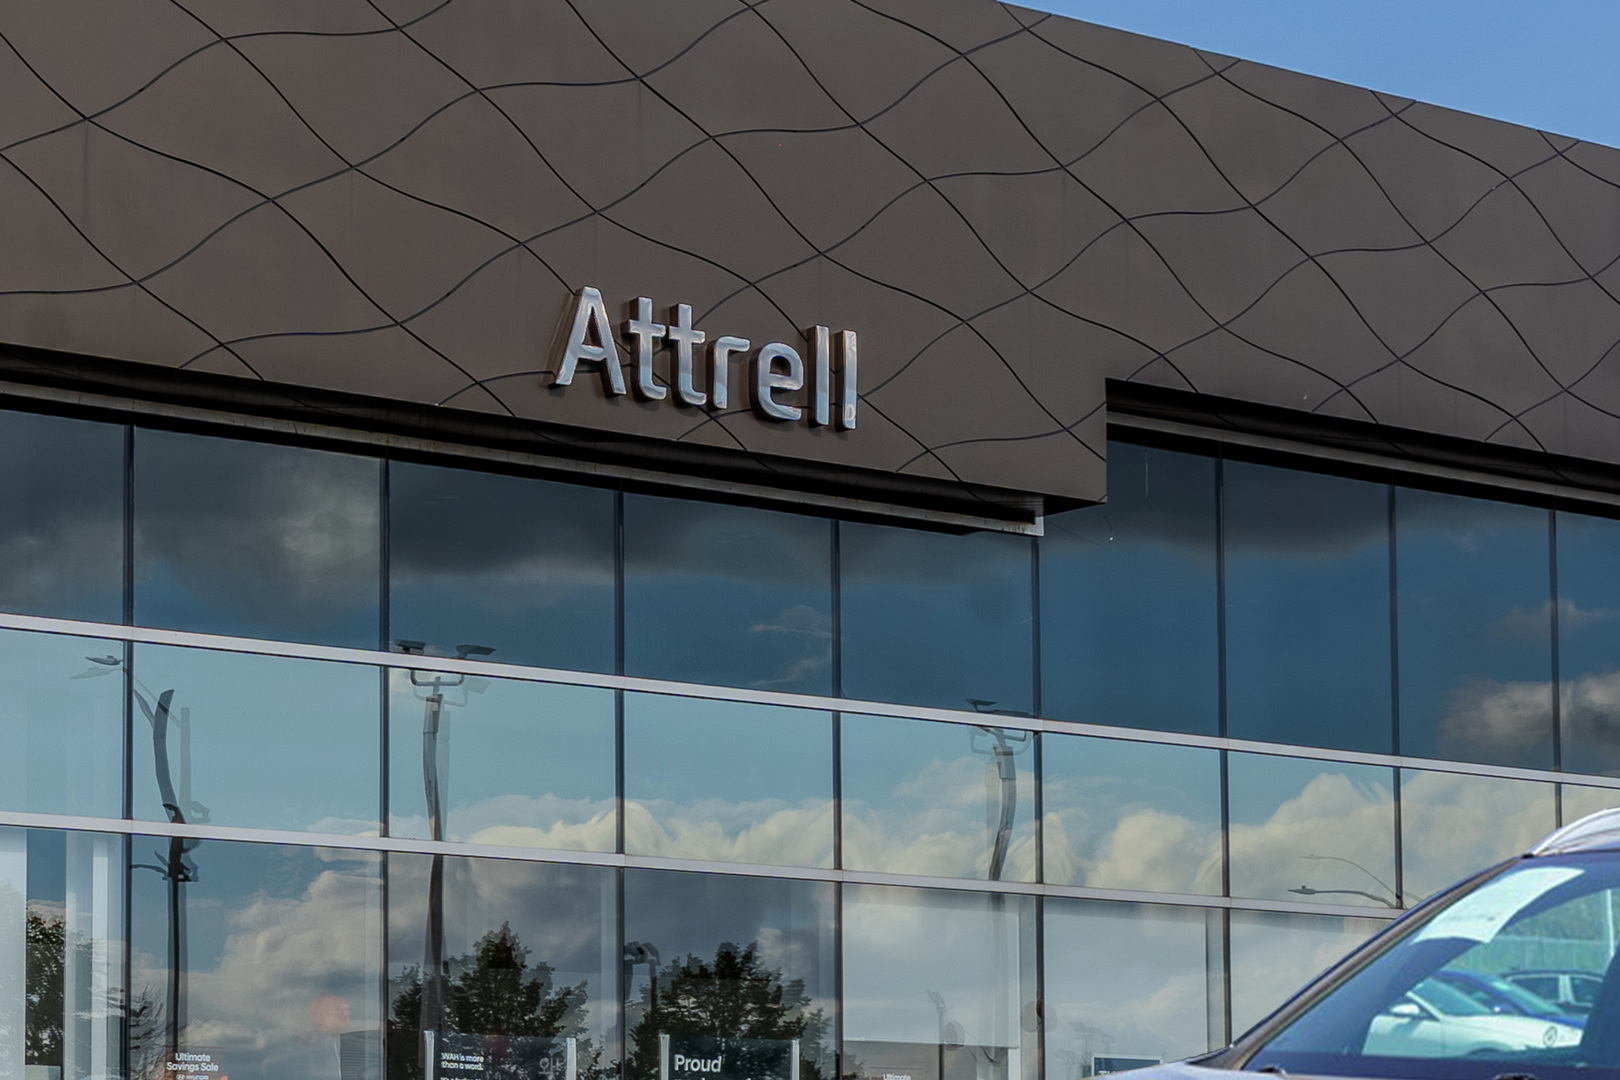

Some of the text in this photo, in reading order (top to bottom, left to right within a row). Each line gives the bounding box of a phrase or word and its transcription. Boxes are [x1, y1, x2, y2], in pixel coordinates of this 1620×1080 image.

[552, 285, 858, 430] Attrell
[175, 1052, 211, 1061] Ultimate
[674, 1054, 722, 1072] Proud
[166, 1062, 219, 1072] Savings Sale
